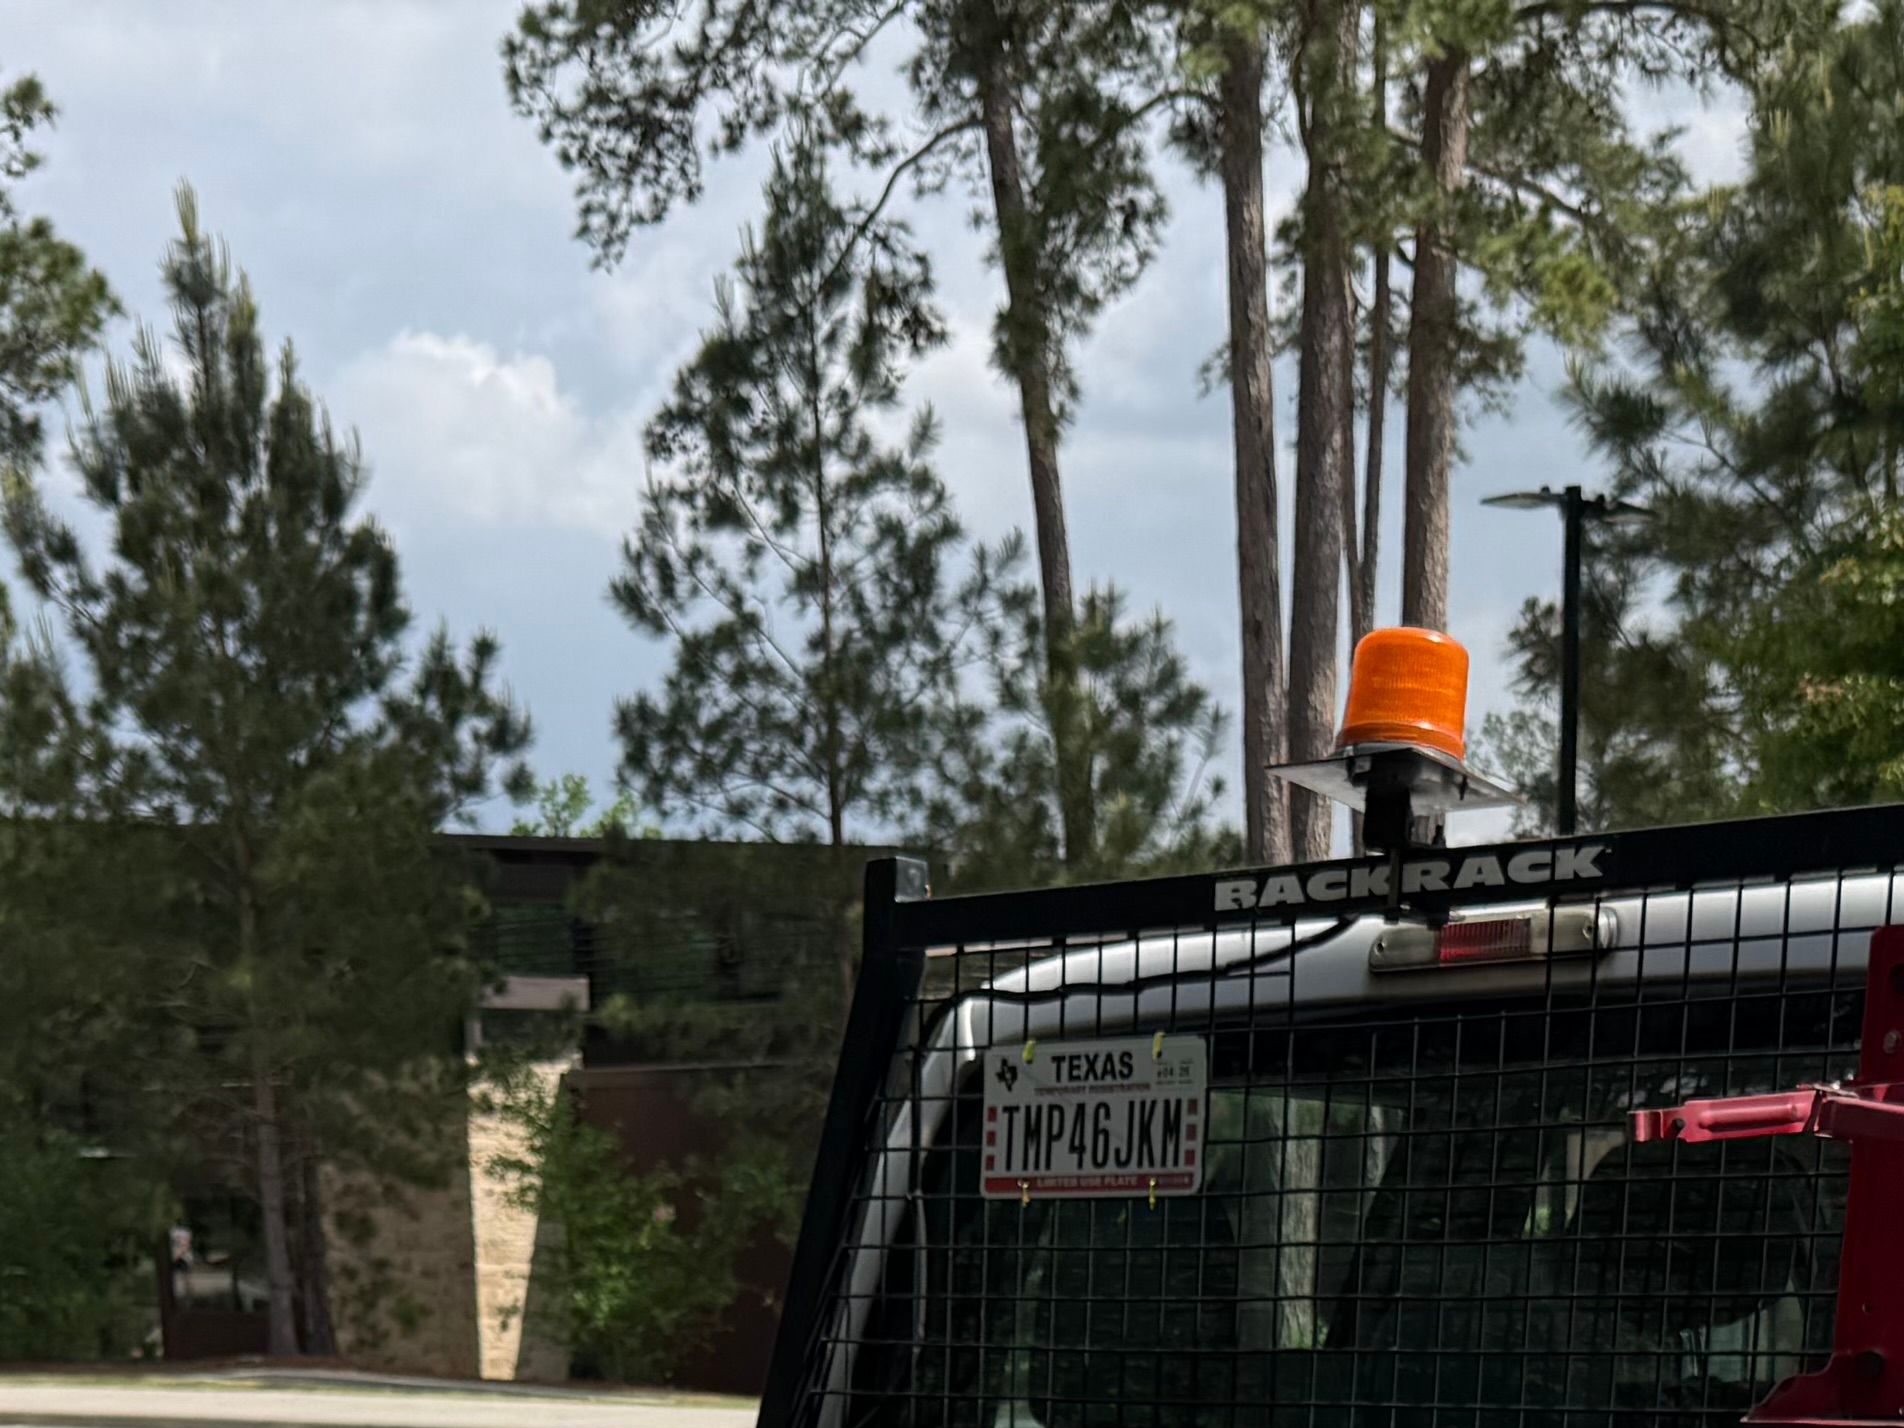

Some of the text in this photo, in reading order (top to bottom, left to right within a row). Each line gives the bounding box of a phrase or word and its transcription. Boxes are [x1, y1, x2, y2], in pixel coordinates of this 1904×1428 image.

[1213, 844, 1604, 912] BACKRACK
[1051, 1051, 1134, 1083] TEXAS
[1001, 1098, 1184, 1171] TMP46JKM
